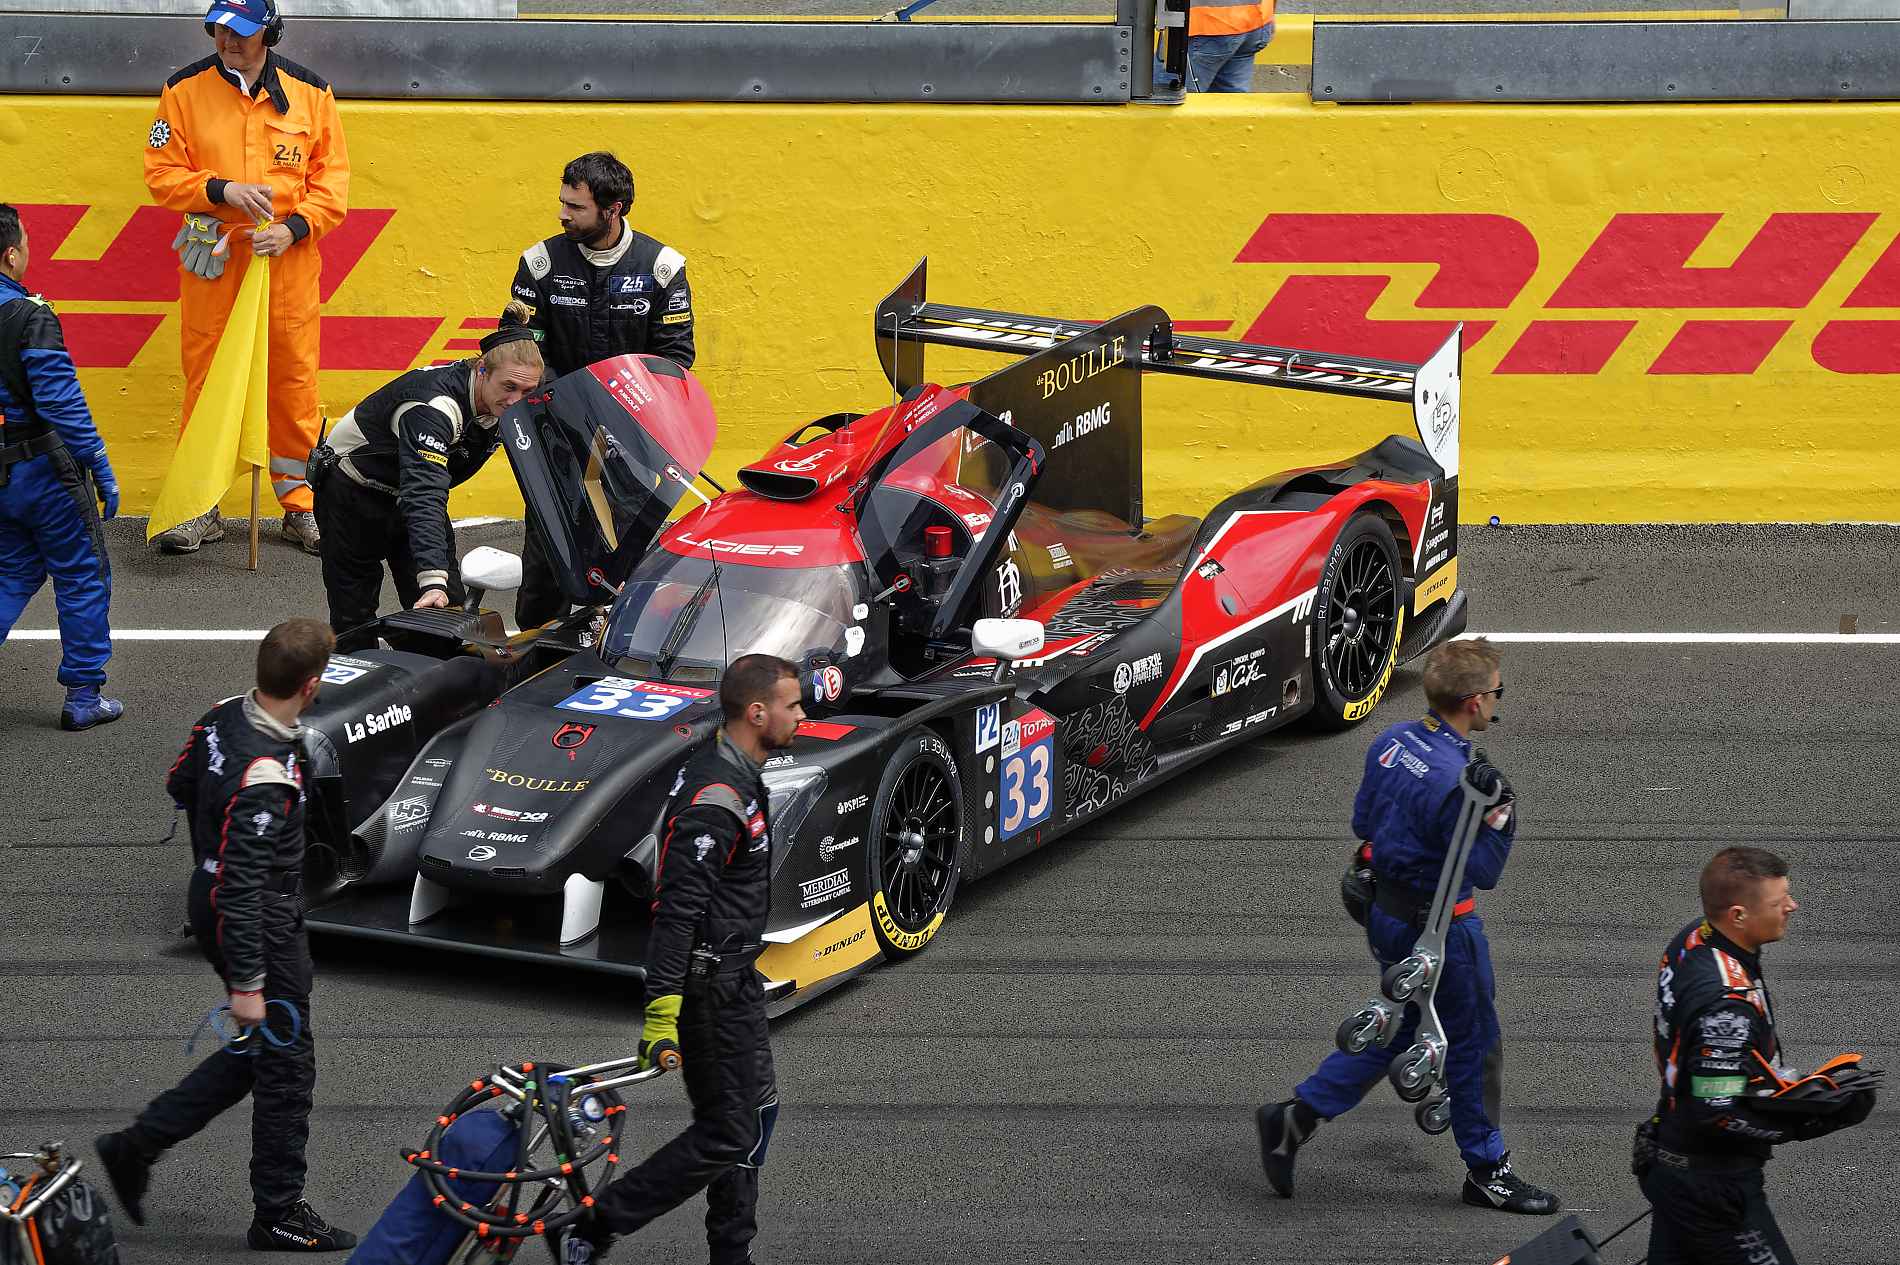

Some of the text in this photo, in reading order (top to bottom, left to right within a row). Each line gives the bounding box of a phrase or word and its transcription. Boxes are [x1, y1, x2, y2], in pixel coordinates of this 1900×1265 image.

[1042, 335, 1125, 400] BOULLE
[1075, 401, 1111, 438] RBMG
[676, 532, 805, 556] LIGIER
[1232, 659, 1267, 689] Café
[566, 687, 683, 718] 33
[642, 684, 705, 697] TOTAL
[343, 703, 412, 744] La Sarthe
[978, 703, 998, 746] P2
[1022, 717, 1056, 738] TOTAL
[1220, 719, 1243, 736] JS
[490, 769, 590, 792] BOULLE
[1003, 745, 1050, 832] 33
[487, 831, 529, 843] RBMG
[802, 870, 850, 898] MERIDIAN
[822, 928, 867, 957] DUNLOP
